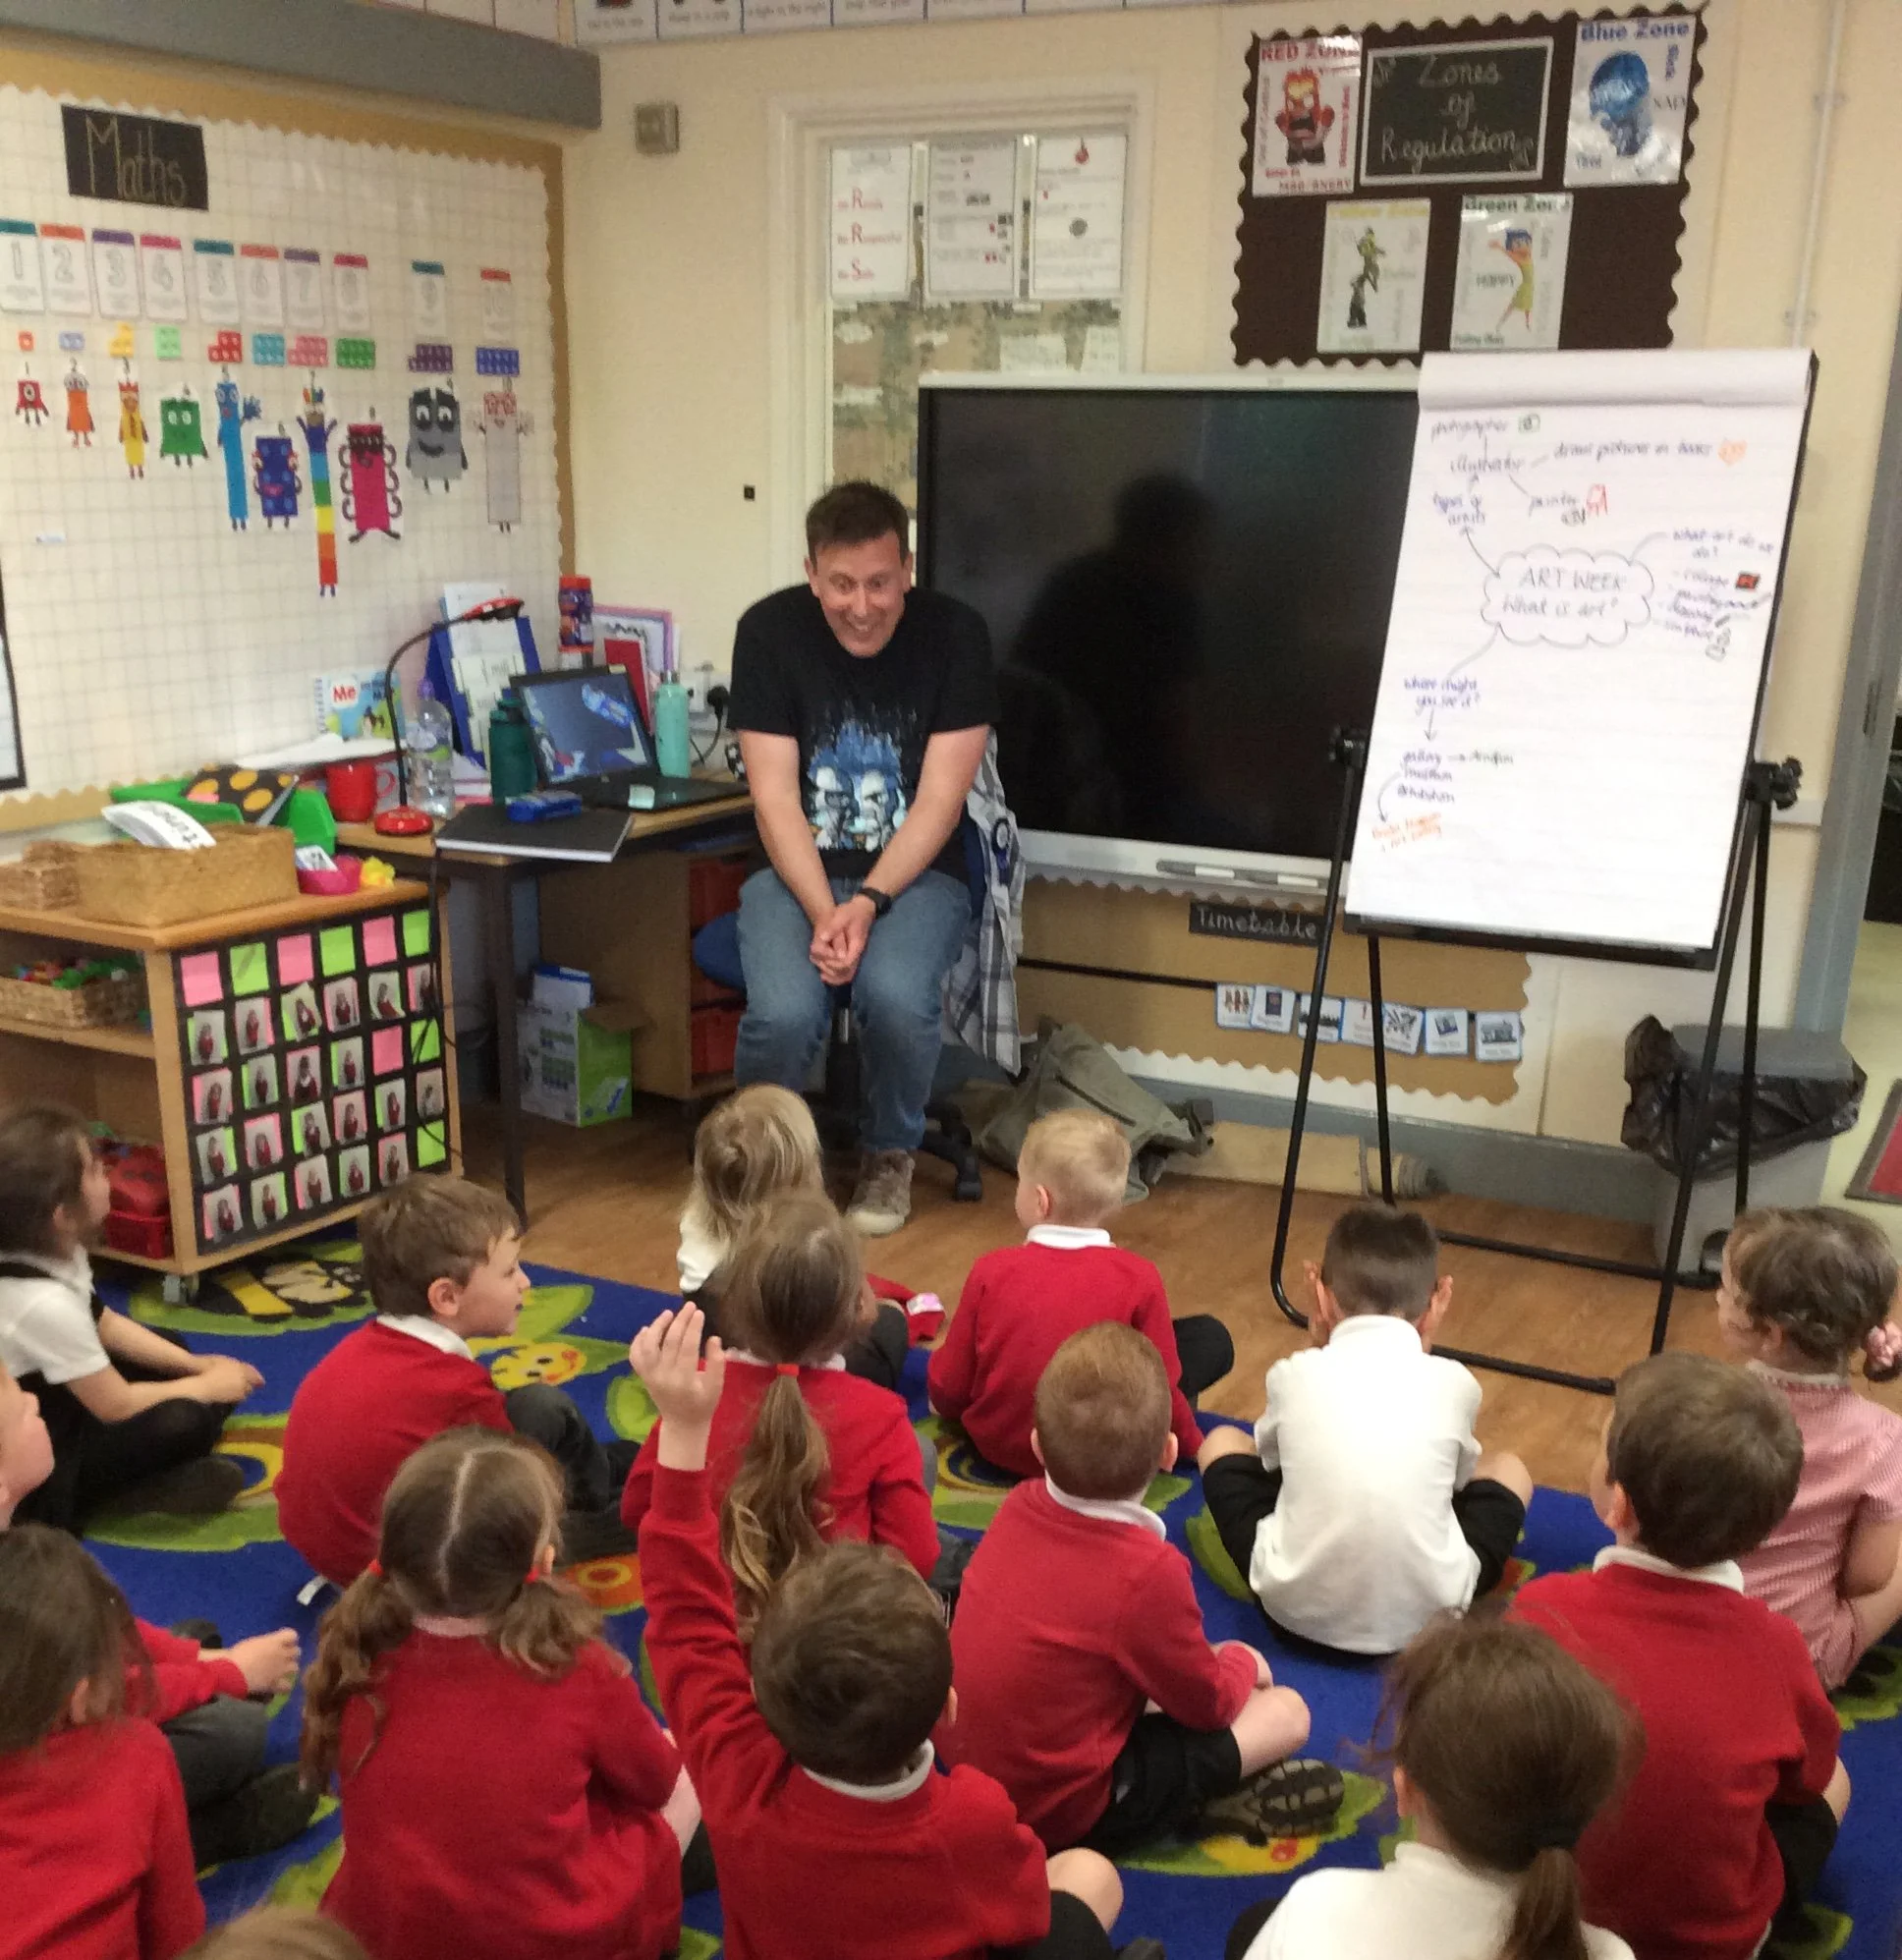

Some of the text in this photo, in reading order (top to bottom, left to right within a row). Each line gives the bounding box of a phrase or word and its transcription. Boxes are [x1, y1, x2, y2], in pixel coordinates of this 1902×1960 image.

[1581, 16, 1690, 41] Blue Zone
[1261, 43, 1300, 62] RED
[1418, 53, 1502, 88] Zones
[1439, 89, 1476, 131] of
[84, 113, 189, 207] Maths
[1380, 124, 1516, 175] Regulation
[1464, 196, 1519, 213] Green
[11, 240, 24, 281] 1
[52, 243, 75, 284] 2
[1520, 565, 1627, 590] ART WEEK
[1502, 592, 1547, 615] What
[1197, 906, 1317, 940] Timetable
